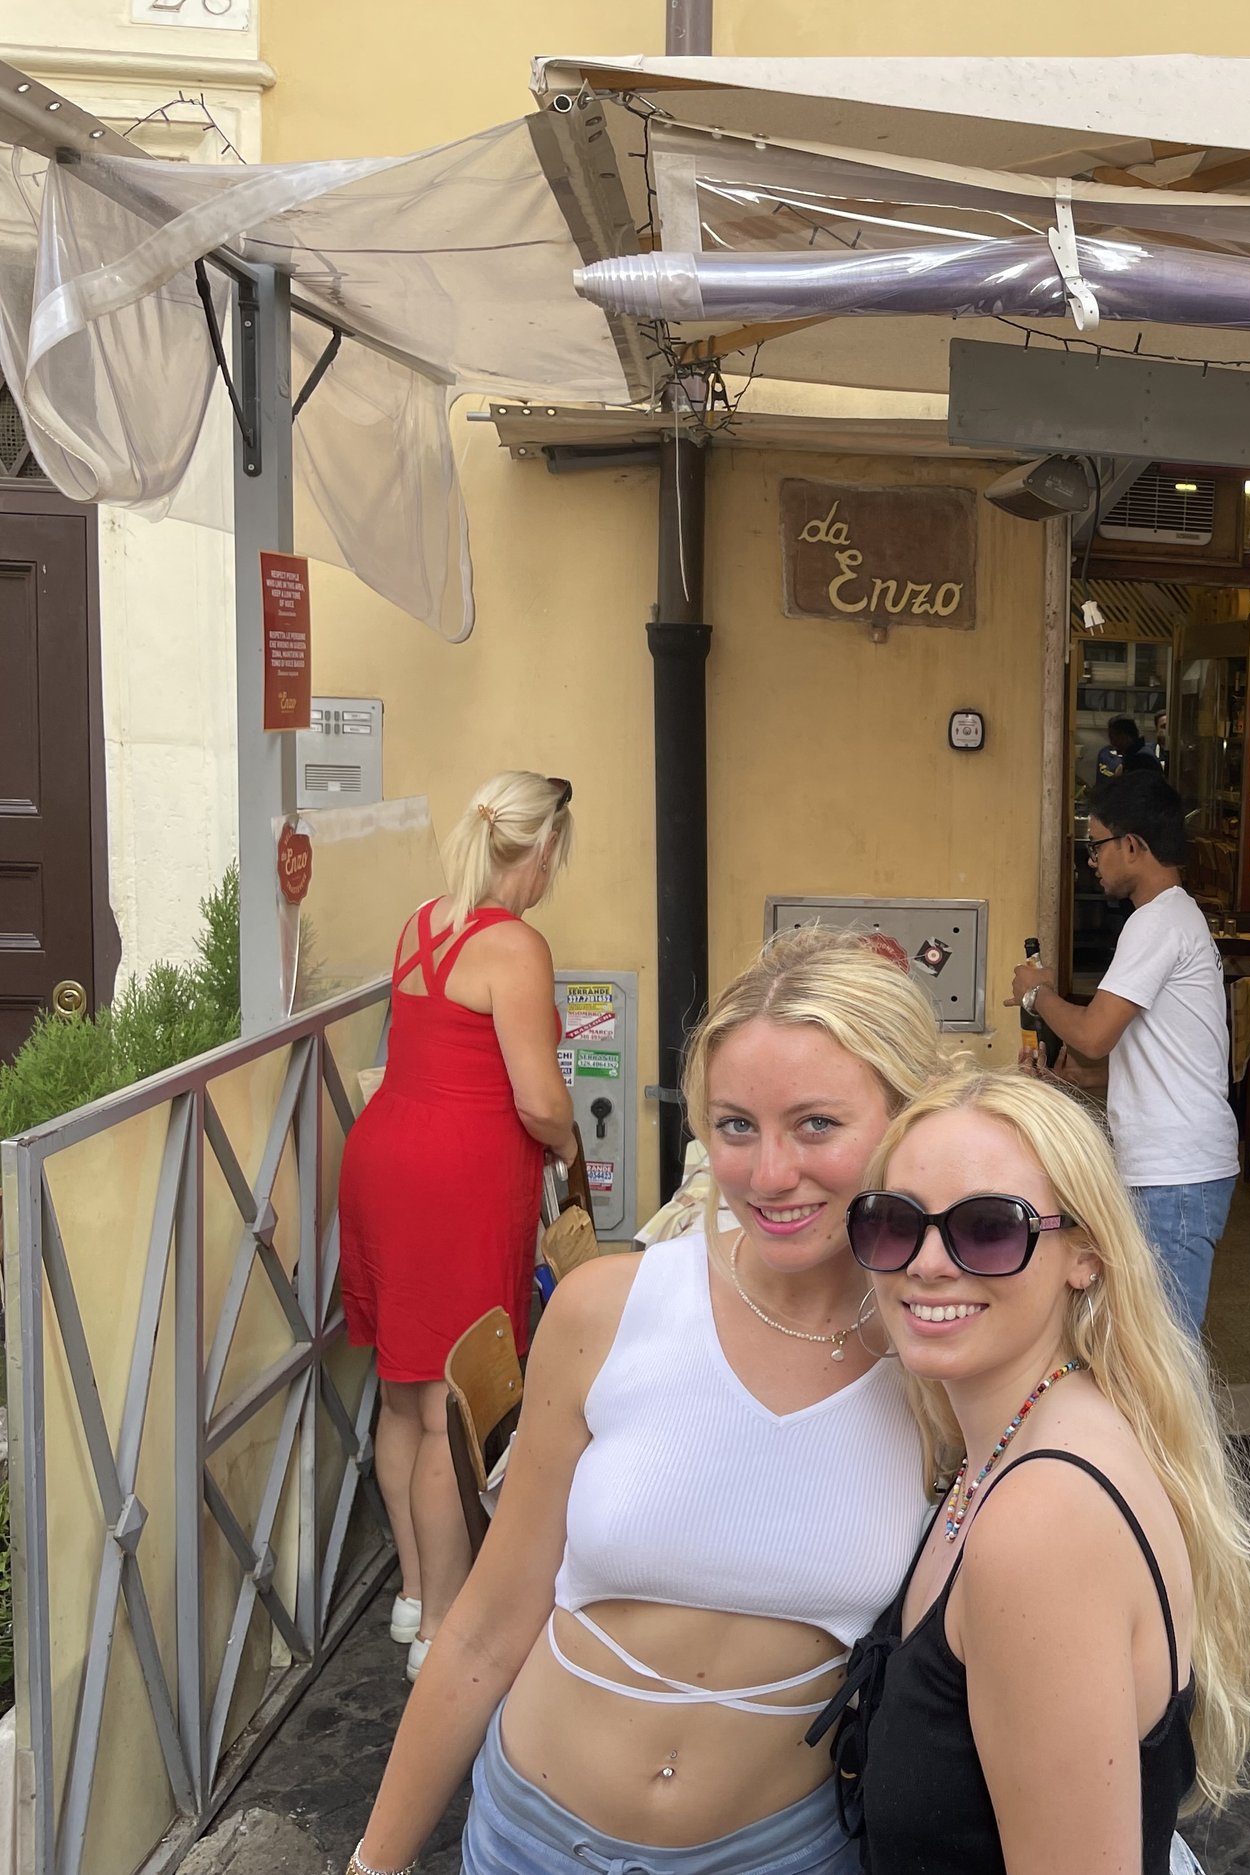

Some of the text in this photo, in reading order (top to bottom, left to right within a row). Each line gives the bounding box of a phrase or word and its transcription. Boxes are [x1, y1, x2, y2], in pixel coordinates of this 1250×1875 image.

[798, 500, 851, 545] da
[829, 549, 964, 617] Enzo
[285, 848, 308, 876] Enzo
